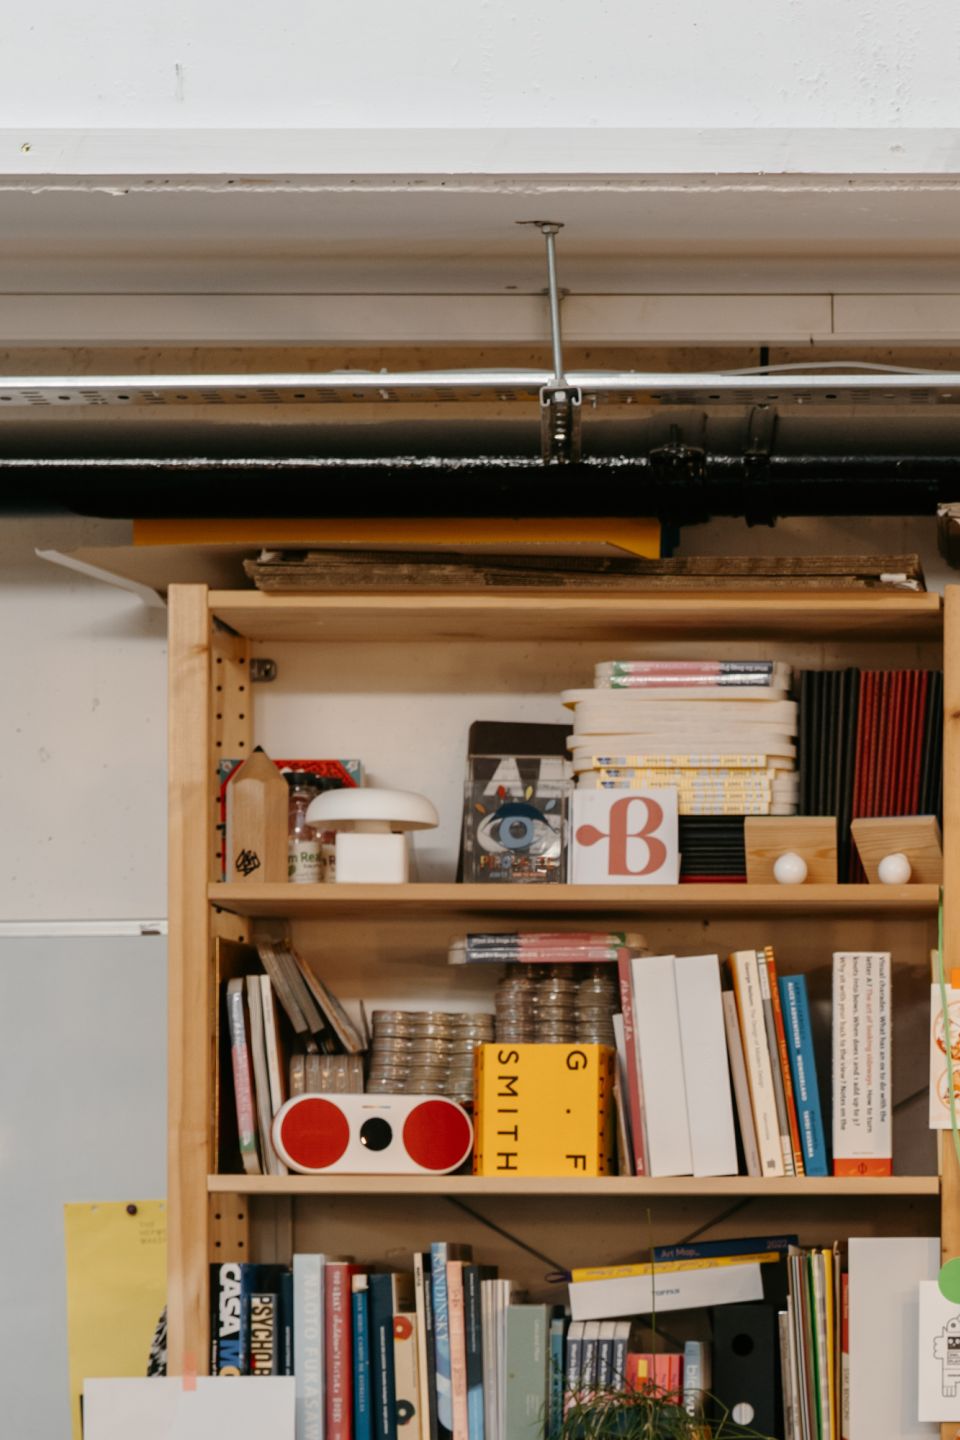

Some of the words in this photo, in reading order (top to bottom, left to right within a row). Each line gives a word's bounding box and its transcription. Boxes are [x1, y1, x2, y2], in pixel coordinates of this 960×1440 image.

[497, 1050, 519, 1170] SMITH
[219, 1263, 242, 1337] CASA
[251, 1296, 272, 1362] PSYCHO
[303, 1275, 319, 1339] NAOTO
[433, 1252, 448, 1343] KANDINSKY
